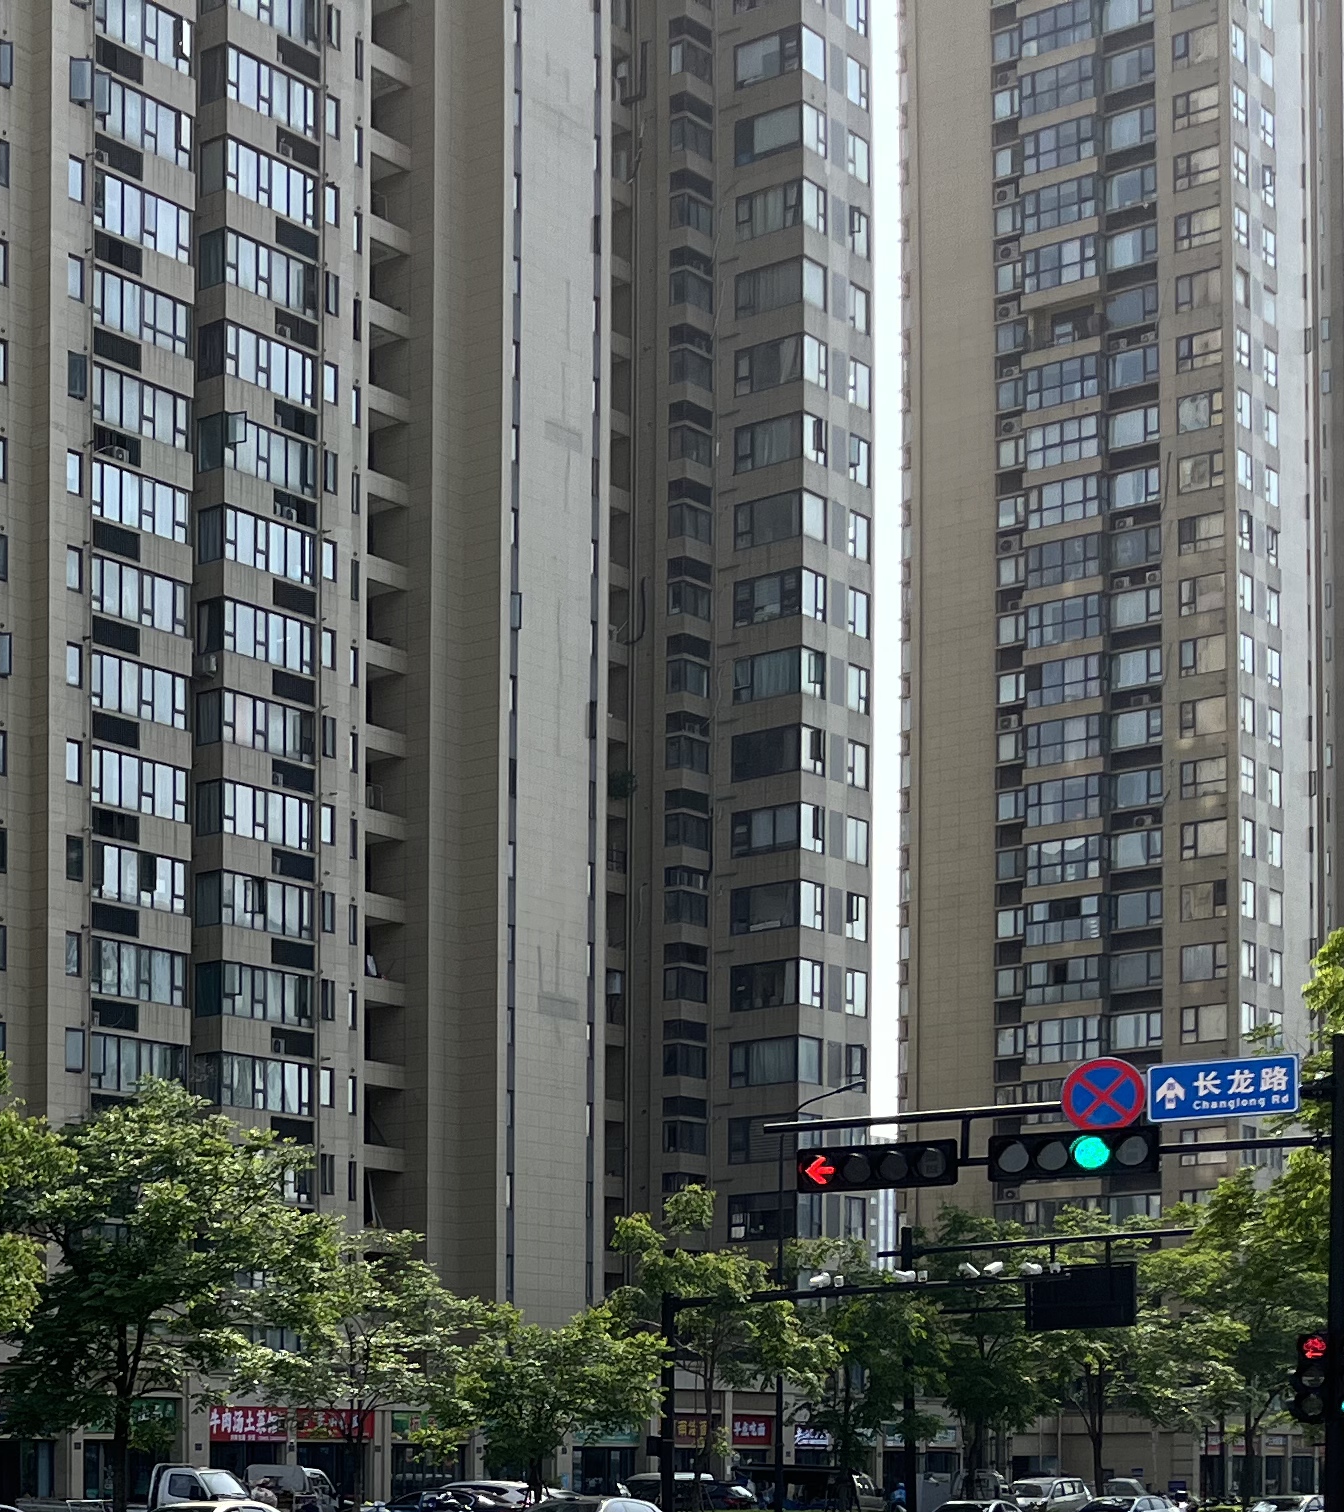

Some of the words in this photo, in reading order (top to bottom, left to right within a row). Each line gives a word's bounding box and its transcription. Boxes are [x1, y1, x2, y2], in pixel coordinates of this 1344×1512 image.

[1192, 1065, 1289, 1097] 长龙路
[1192, 1097, 1266, 1110] Changlong
[1271, 1094, 1289, 1105] Rd
